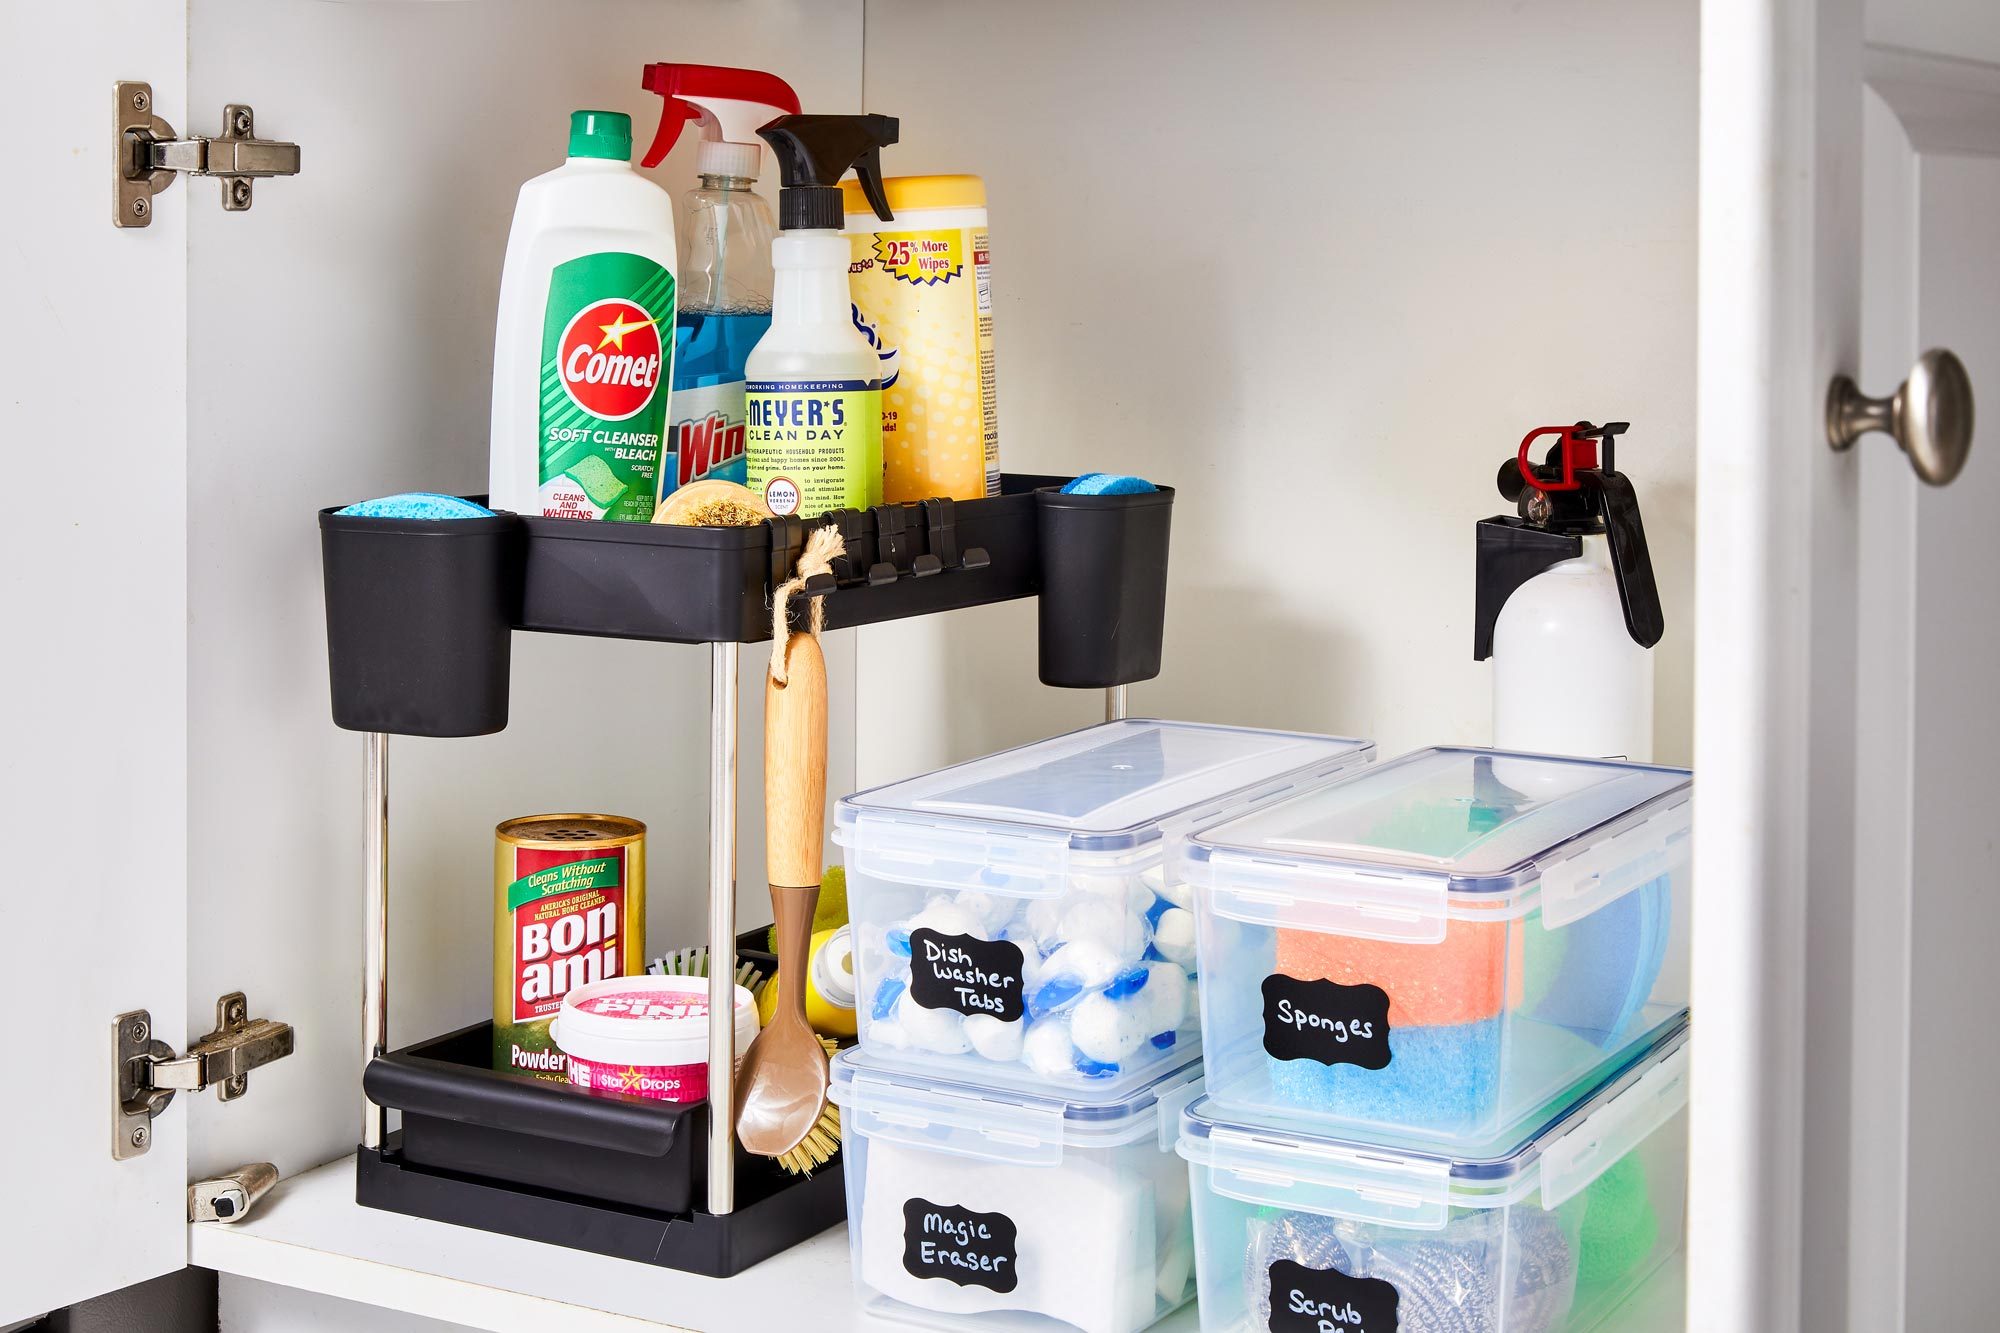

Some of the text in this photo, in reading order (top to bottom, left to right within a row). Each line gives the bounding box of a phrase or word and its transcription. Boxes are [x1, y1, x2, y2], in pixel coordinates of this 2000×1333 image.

[921, 241, 948, 252] More
[919, 258, 950, 272] Wipes
[565, 343, 658, 388] Comet
[549, 426, 659, 447] SOFT CLEANSER
[749, 429, 844, 441] CLEAN DAY
[614, 447, 657, 461] BLEACH
[631, 464, 654, 472] SCRATCH
[552, 493, 585, 502] CLEANS
[559, 501, 578, 510] AND
[543, 508, 593, 520] WHITENS
[527, 862, 606, 888] Cleans Without
[541, 876, 594, 896] Scratching
[534, 895, 606, 921] NATURAL HOME CLEANER
[540, 890, 600, 913] AMERICA'S ORIGINAL
[522, 902, 617, 961] Bon
[923, 939, 973, 967] Dish
[521, 939, 617, 1002] ami
[953, 987, 1005, 1013] Tabs
[1277, 999, 1373, 1043] Sponges
[511, 1044, 566, 1070] Powder
[601, 1074, 624, 1087] Star
[641, 1078, 681, 1091] Drops
[923, 1213, 992, 1246] Magic
[920, 1241, 1008, 1273] Eraser
[1288, 1288, 1362, 1325] Scrub
